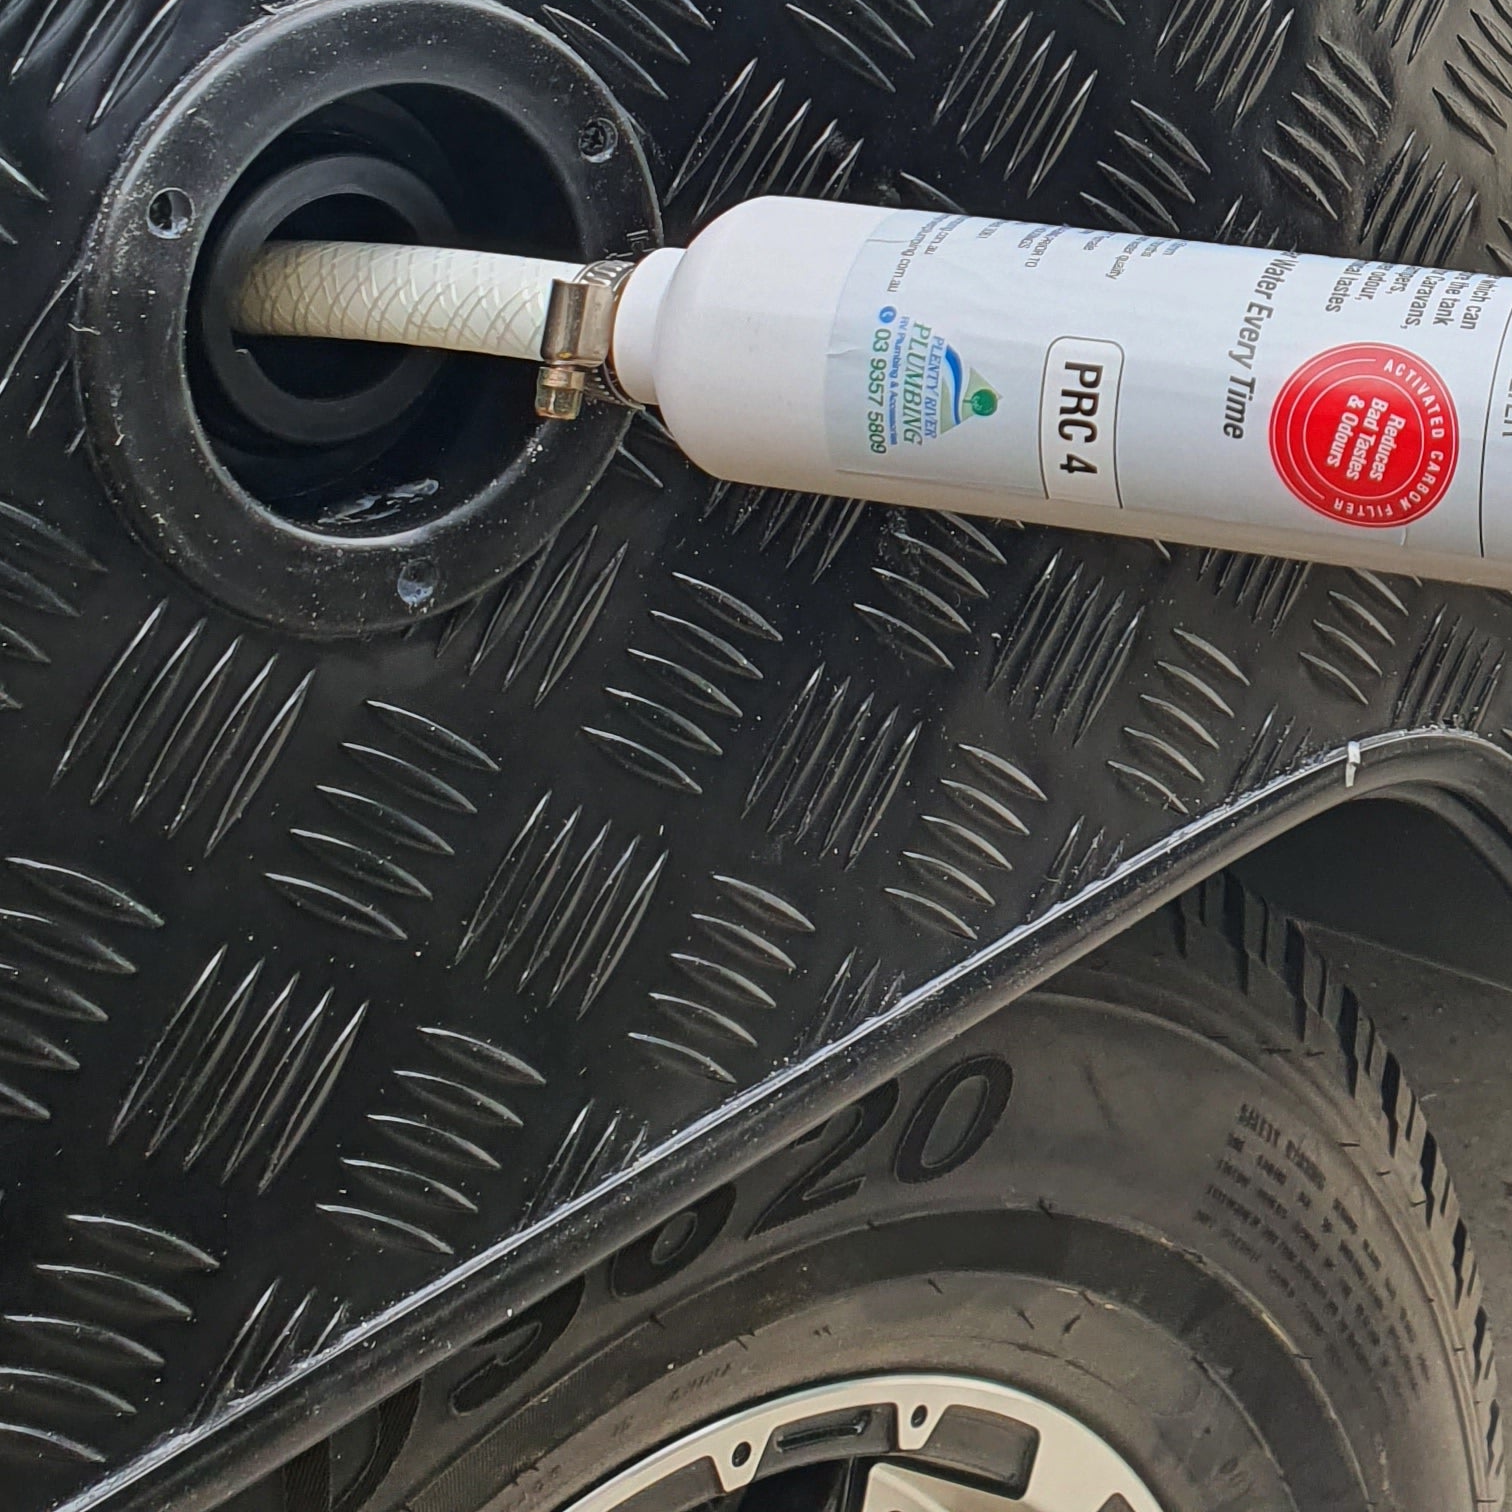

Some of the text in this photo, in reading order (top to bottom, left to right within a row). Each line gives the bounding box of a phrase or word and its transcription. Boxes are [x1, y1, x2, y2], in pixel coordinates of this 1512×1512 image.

[1025, 257, 1041, 268] TO
[1106, 255, 1129, 279] quality
[1254, 259, 1300, 300] Water
[1355, 271, 1386, 300] odour,
[1445, 279, 1470, 296] the
[1470, 278, 1498, 302] which
[1325, 277, 1360, 313] tastes
[1400, 275, 1446, 330] Caravans,
[1432, 298, 1461, 327] tank
[1460, 305, 1482, 330] can
[889, 332, 907, 379] Plumbing
[1228, 301, 1274, 370] Every
[867, 328, 891, 454] 03 9357 5809
[903, 322, 932, 446] PLUMBING
[924, 335, 945, 439] PLENTY RIVER
[1223, 375, 1257, 439] Time
[1058, 361, 1104, 475] PRC 4
[1327, 395, 1366, 468] & Odours
[1333, 359, 1445, 518] ACTIVATED CARBON FILTER
[1346, 397, 1389, 481] Bad Tastes
[1370, 413, 1407, 481] Reduces
